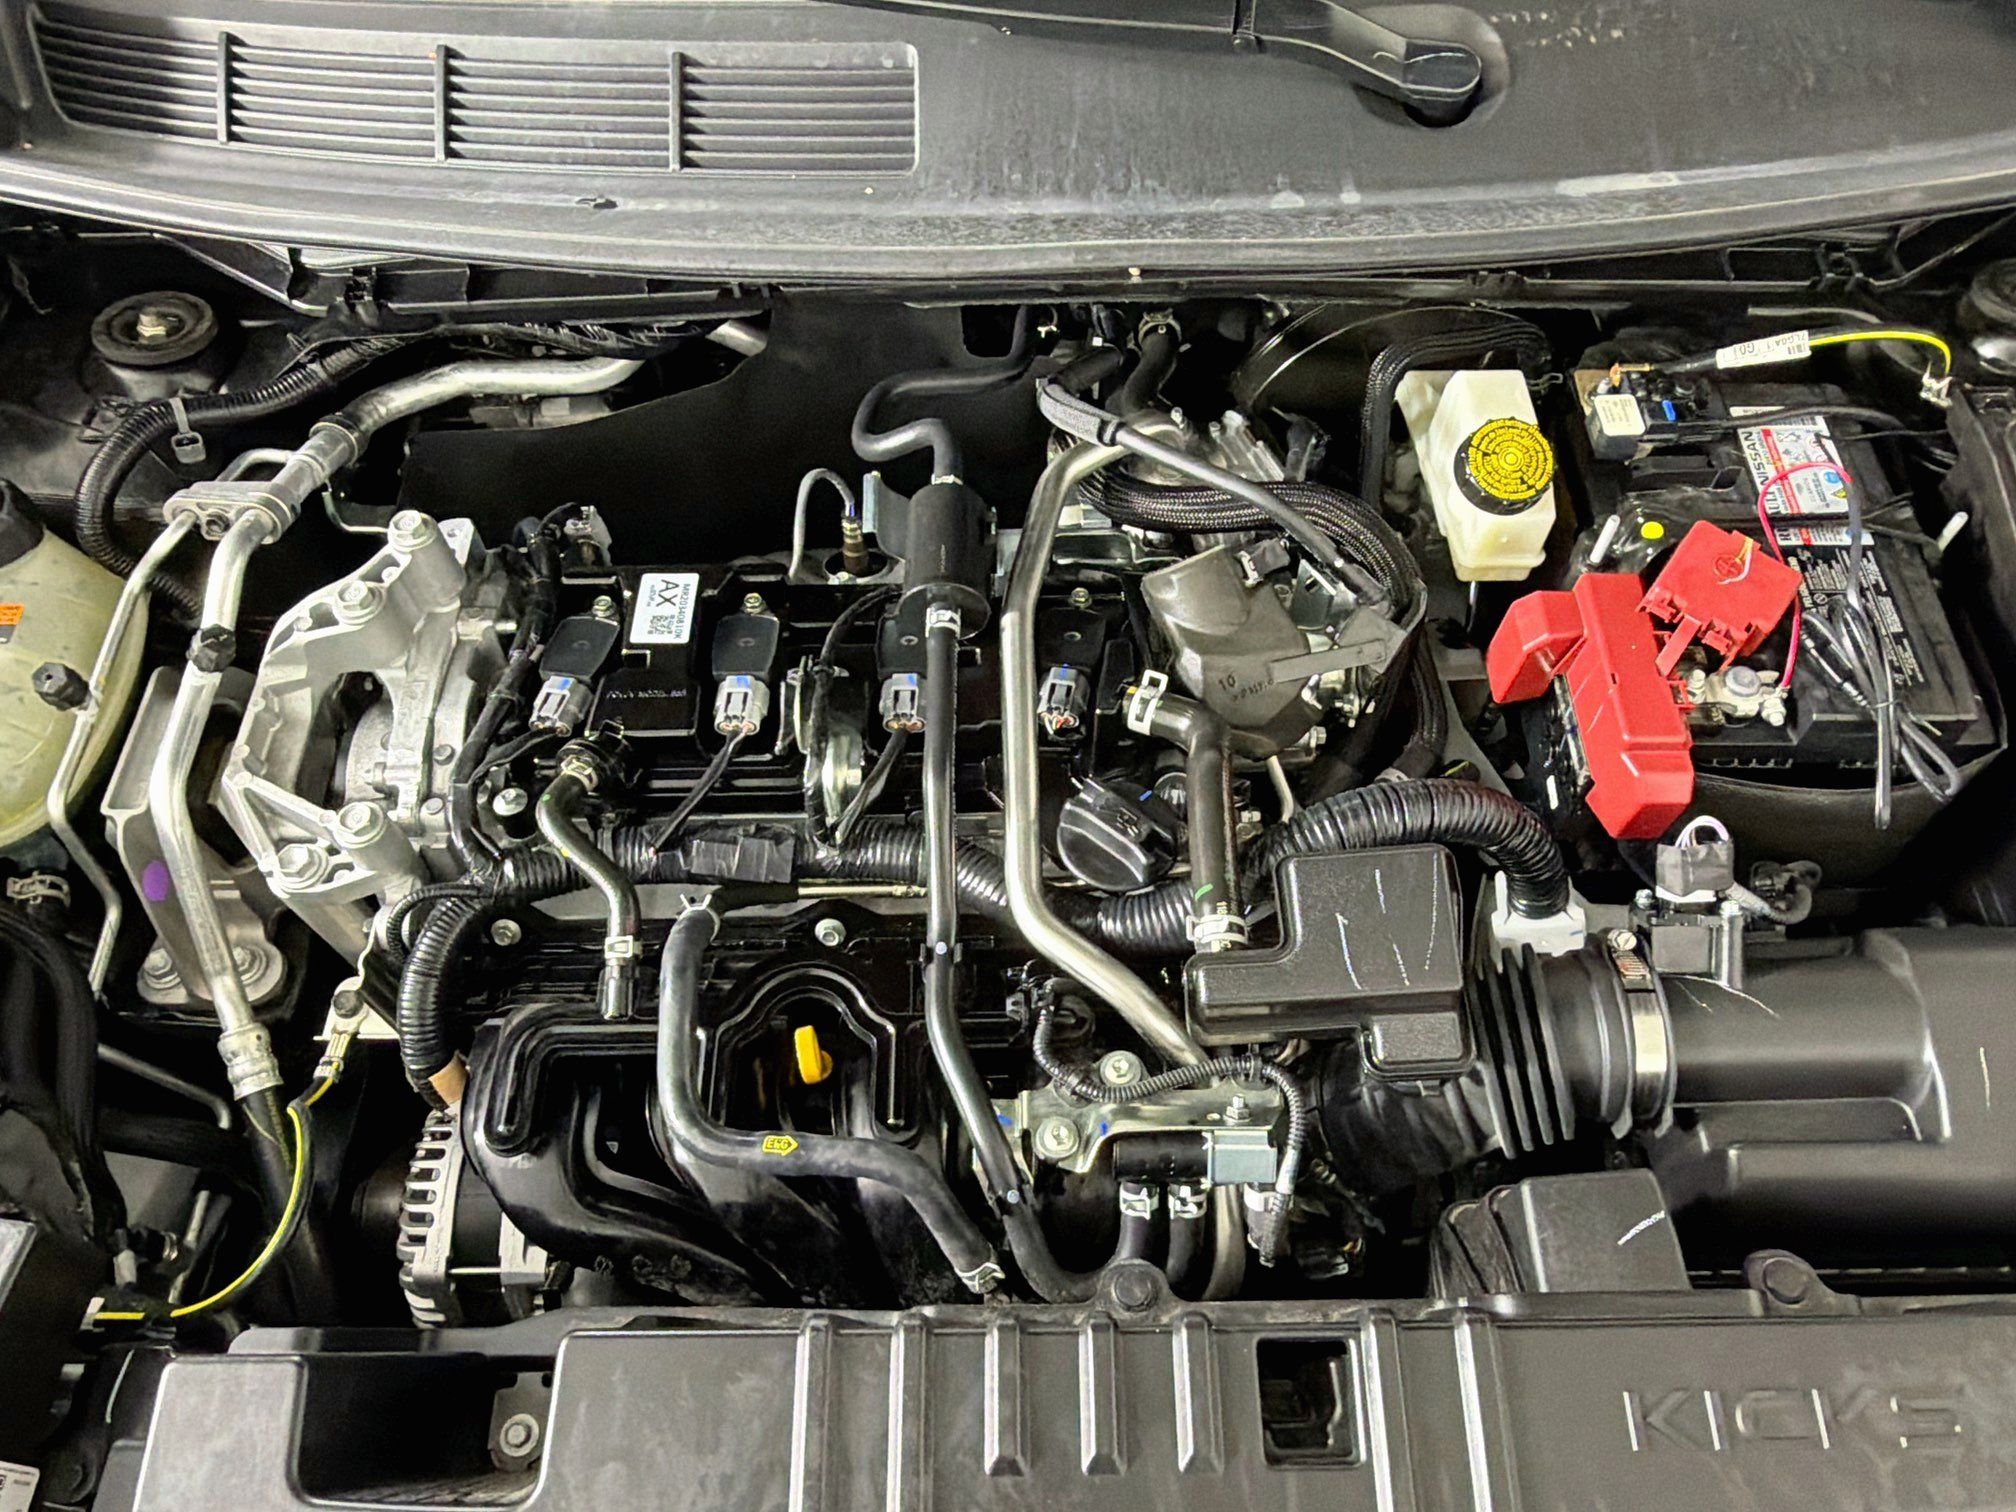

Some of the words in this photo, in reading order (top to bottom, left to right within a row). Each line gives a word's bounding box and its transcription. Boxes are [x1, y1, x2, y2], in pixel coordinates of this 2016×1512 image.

[1741, 431, 1771, 486] NISSAN
[655, 579, 680, 607] AX
[1622, 1388, 1964, 1452] KICKS
